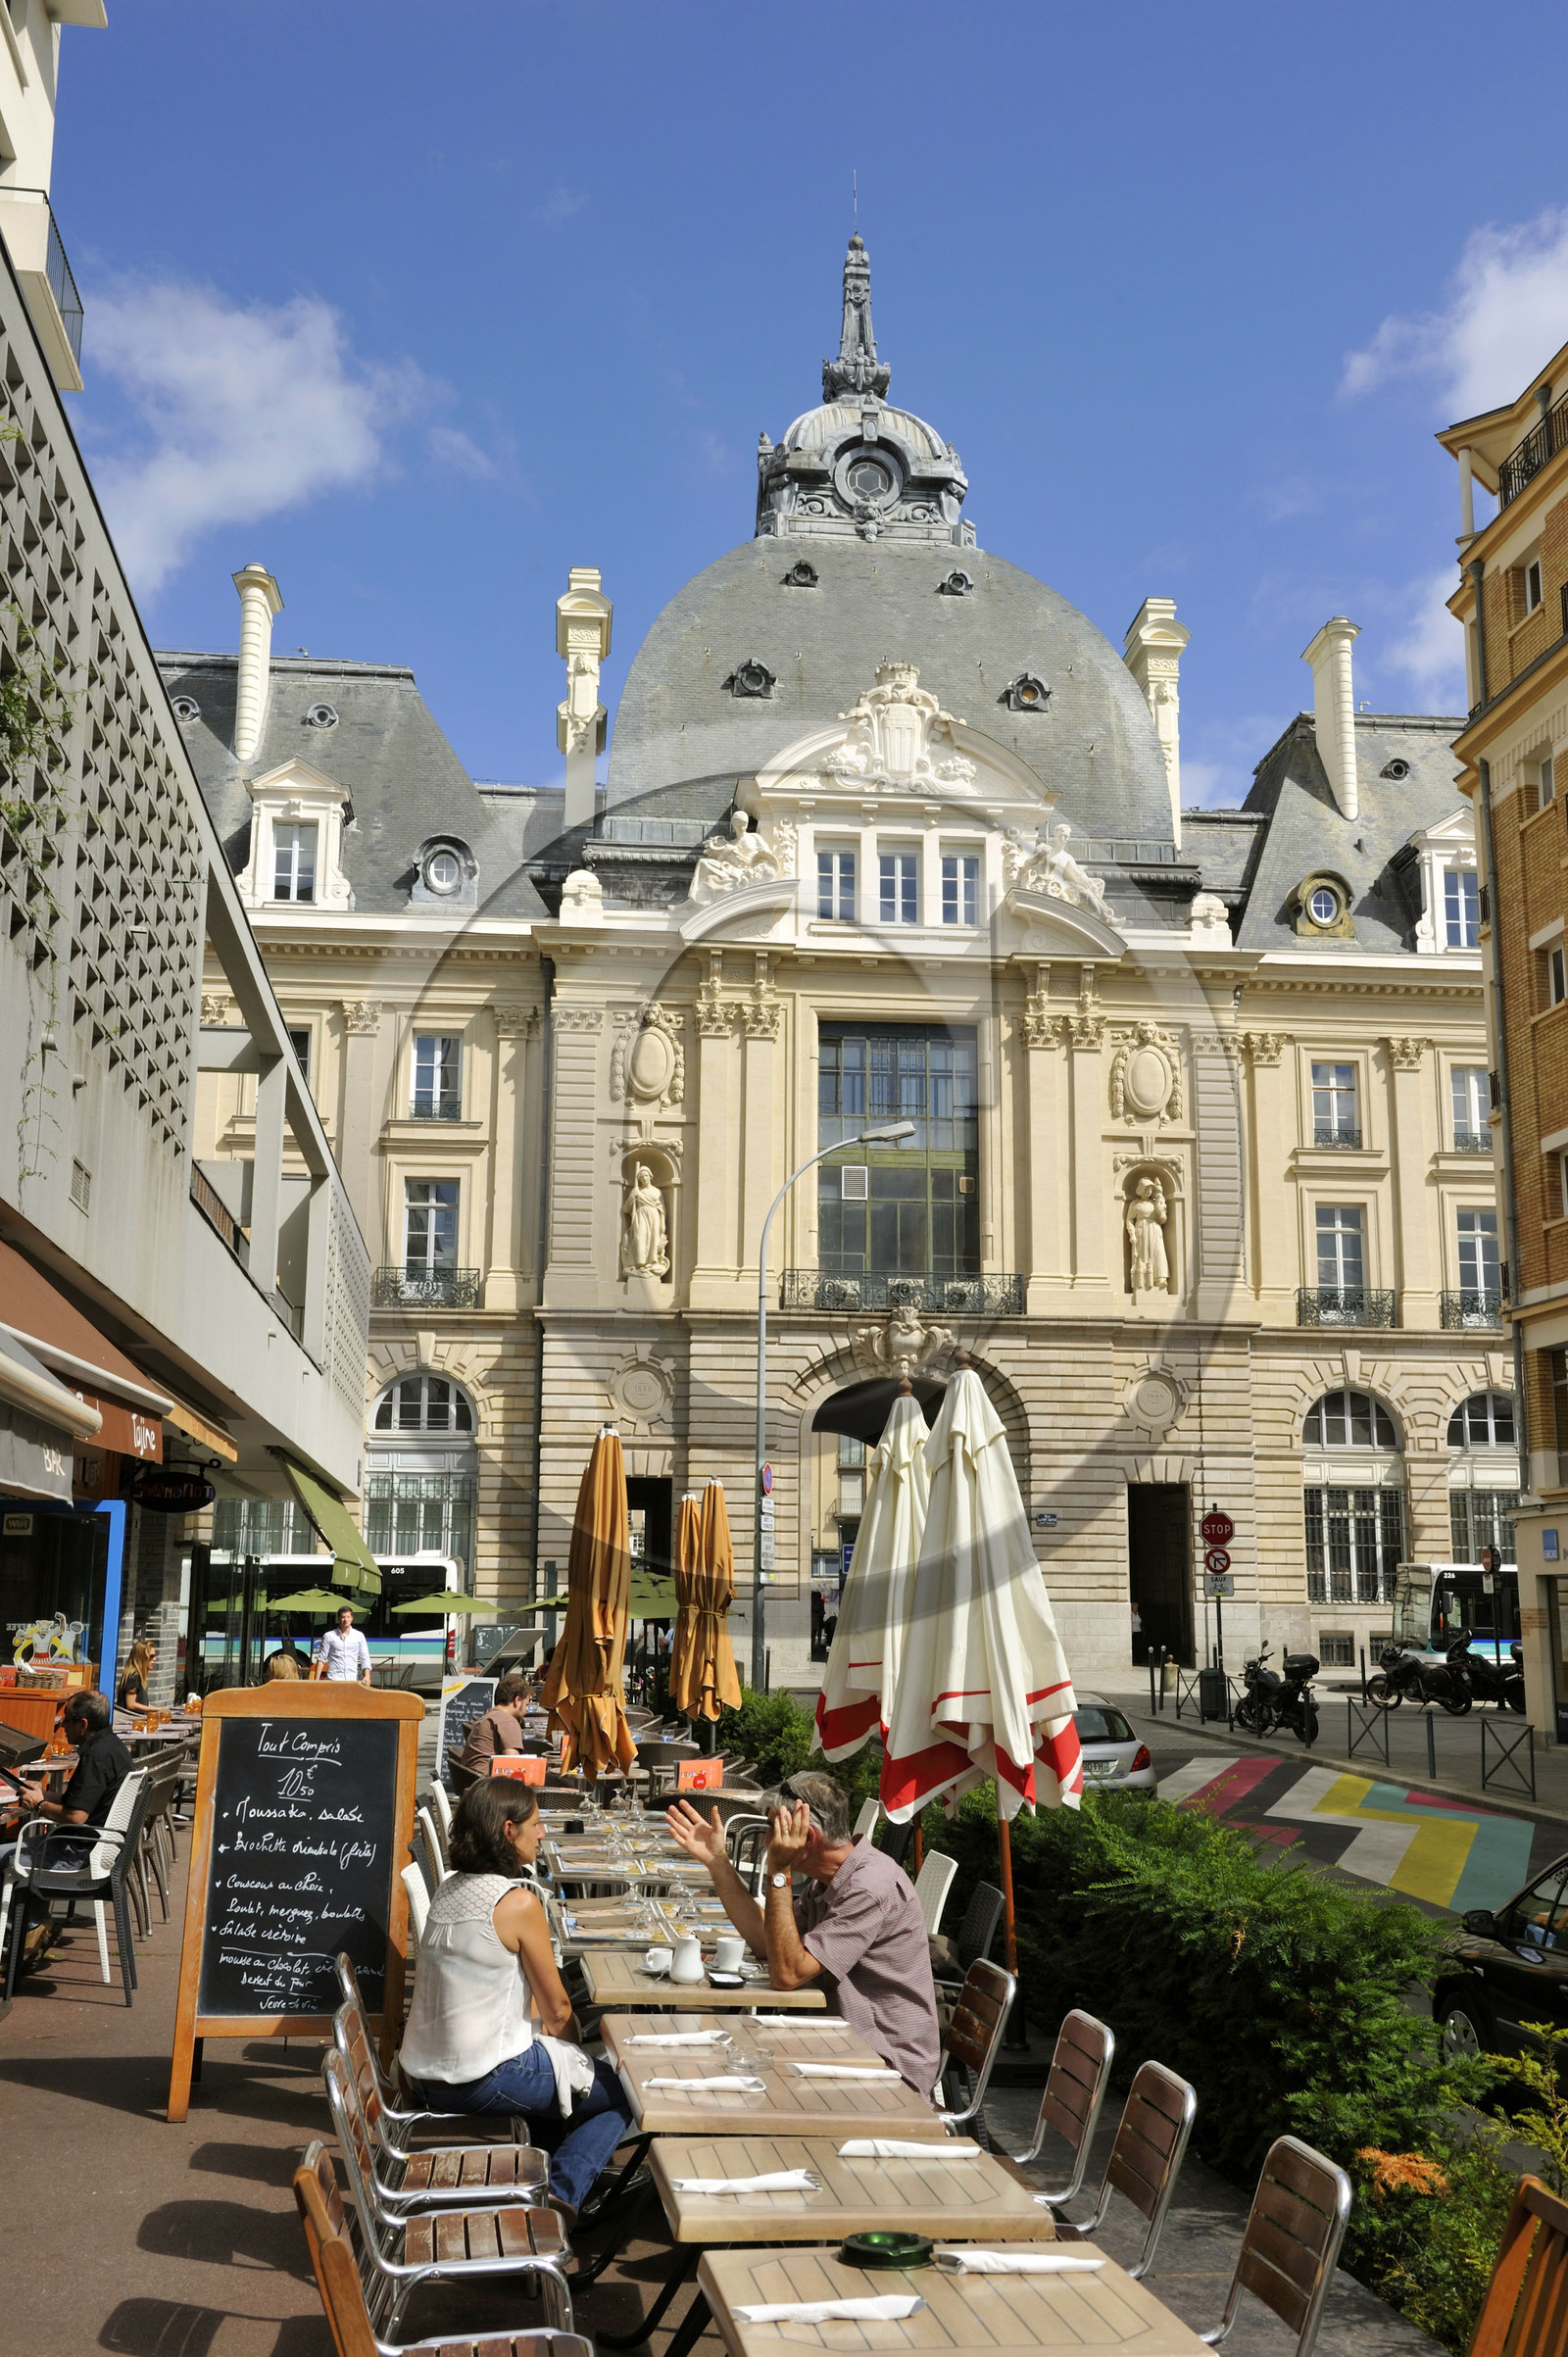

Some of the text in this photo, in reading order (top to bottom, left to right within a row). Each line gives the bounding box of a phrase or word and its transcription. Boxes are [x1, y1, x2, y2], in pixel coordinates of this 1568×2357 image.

[131, 1412, 156, 1456] Tajine
[43, 1443, 66, 1477] BAR
[1203, 1524, 1231, 1535] STOP
[258, 1723, 340, 1761] Tout Compris
